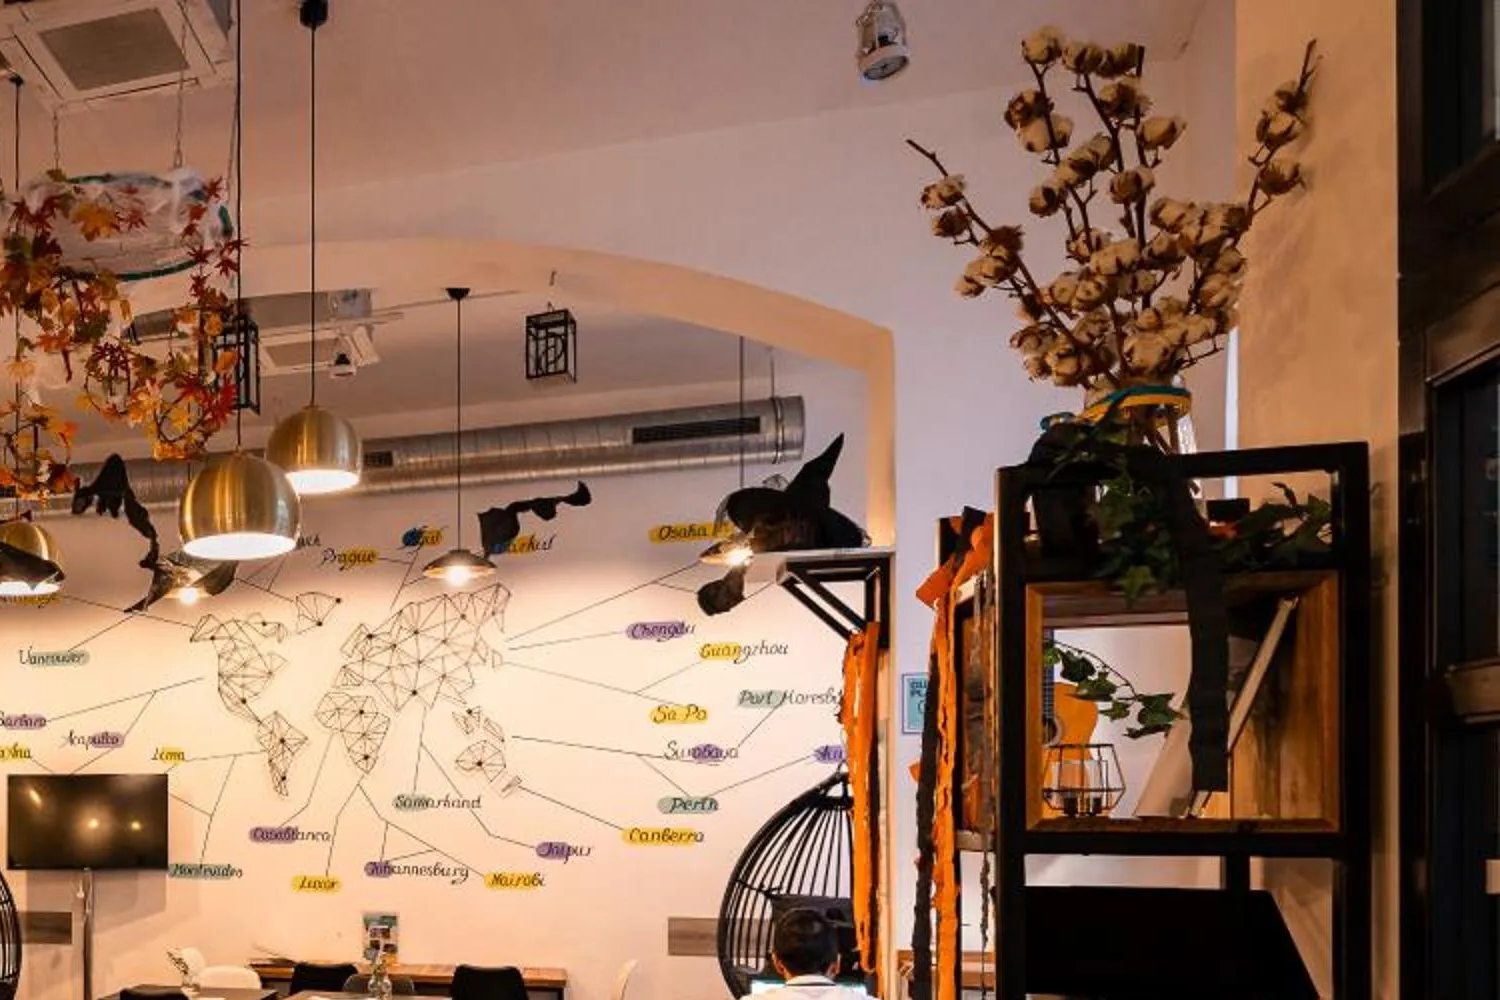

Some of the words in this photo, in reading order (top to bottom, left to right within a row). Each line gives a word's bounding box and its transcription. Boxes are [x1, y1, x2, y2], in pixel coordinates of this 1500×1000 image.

[321, 547, 377, 571] Prague
[631, 621, 696, 643] Chengdu
[19, 645, 85, 665] Vancouver
[700, 640, 789, 665] Guangzhou
[653, 703, 677, 724] Sa
[669, 796, 719, 814] Perth
[252, 826, 330, 842] Casablanca
[629, 827, 705, 843] Canberra
[299, 875, 338, 890] Luxor
[490, 871, 546, 888] Nairobi
